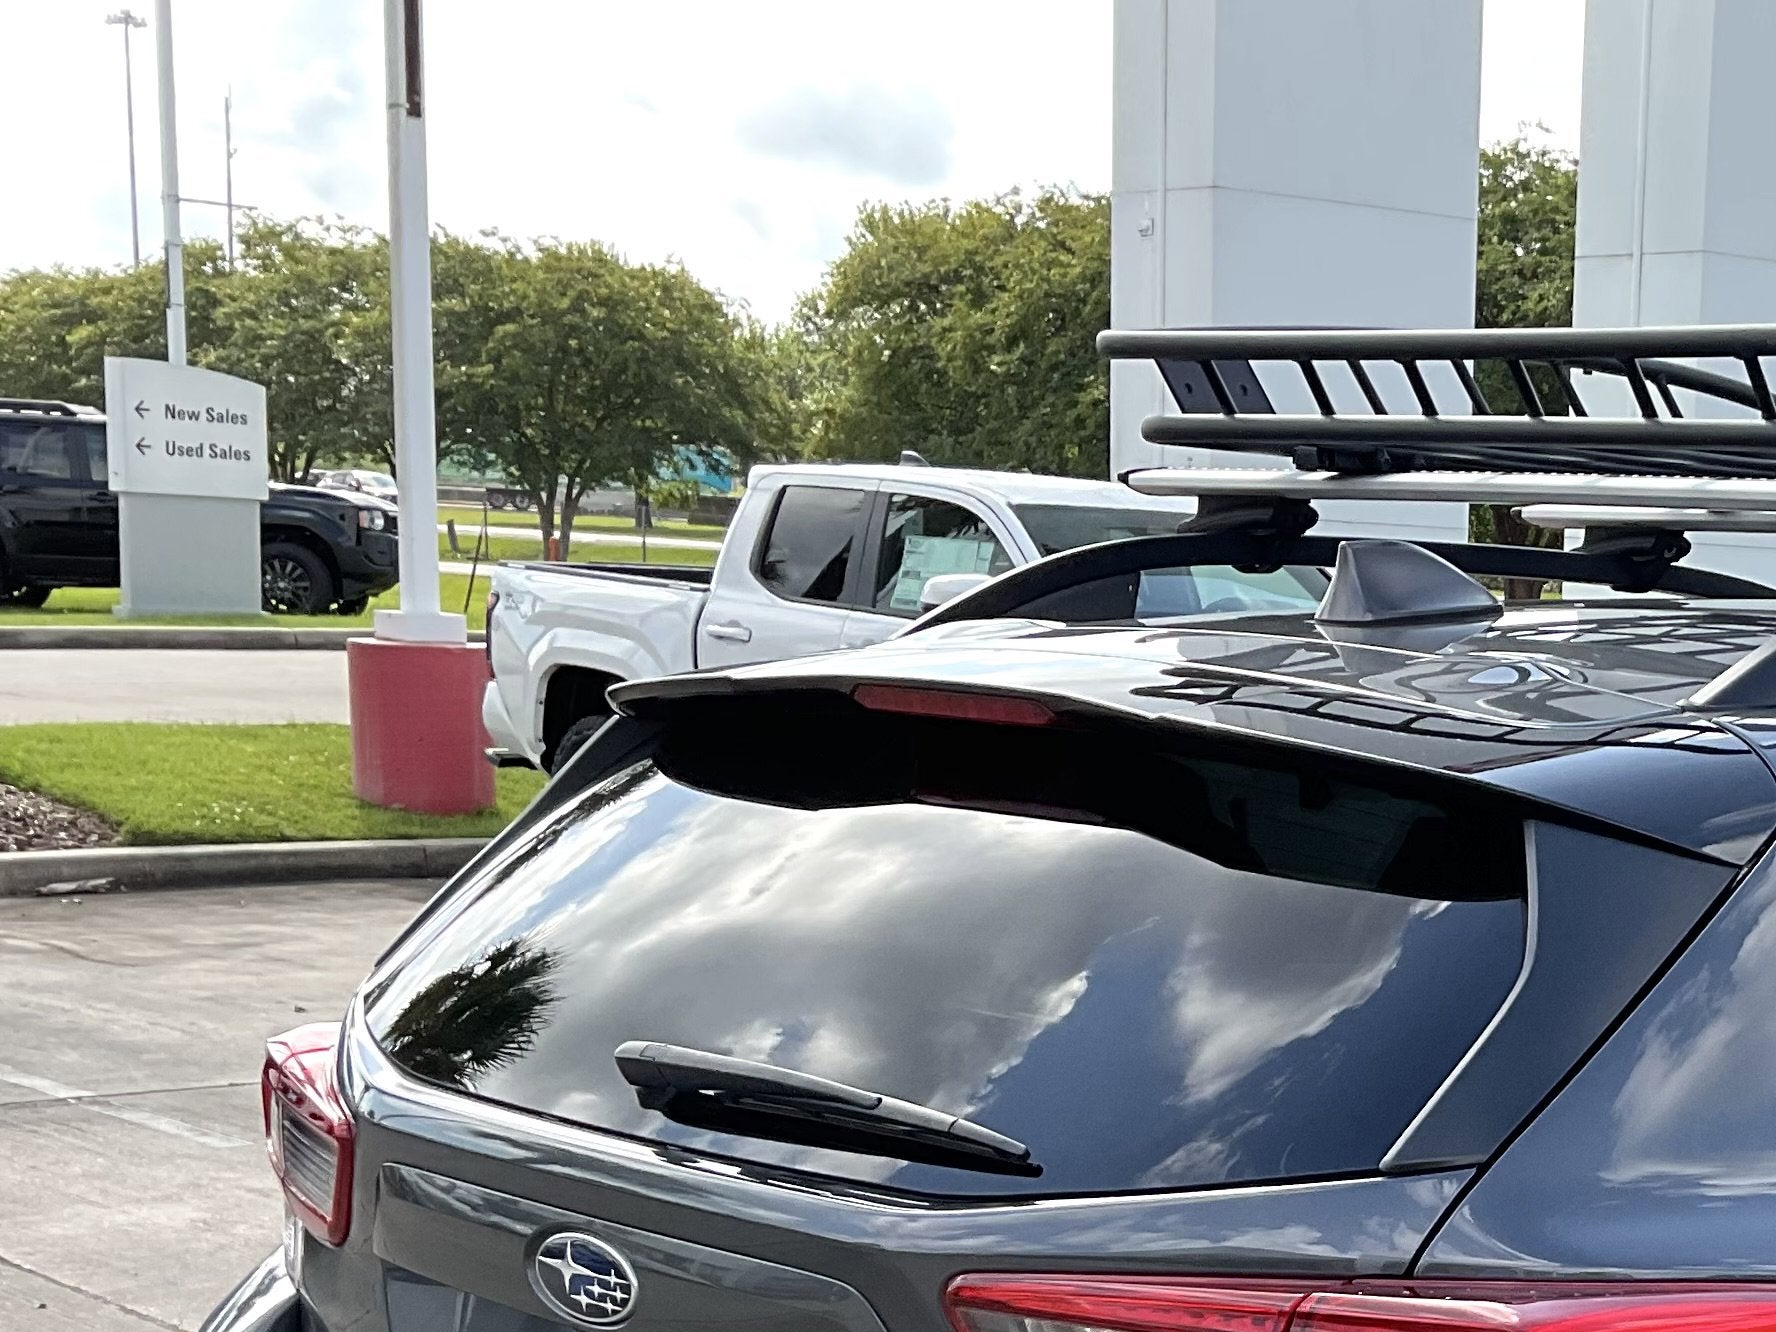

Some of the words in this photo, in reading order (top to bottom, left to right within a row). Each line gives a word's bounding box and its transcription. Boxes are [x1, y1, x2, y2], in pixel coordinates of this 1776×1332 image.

[164, 403, 201, 421] New
[205, 407, 248, 425] Sales
[165, 440, 204, 458] Used
[208, 443, 251, 461] Sales
